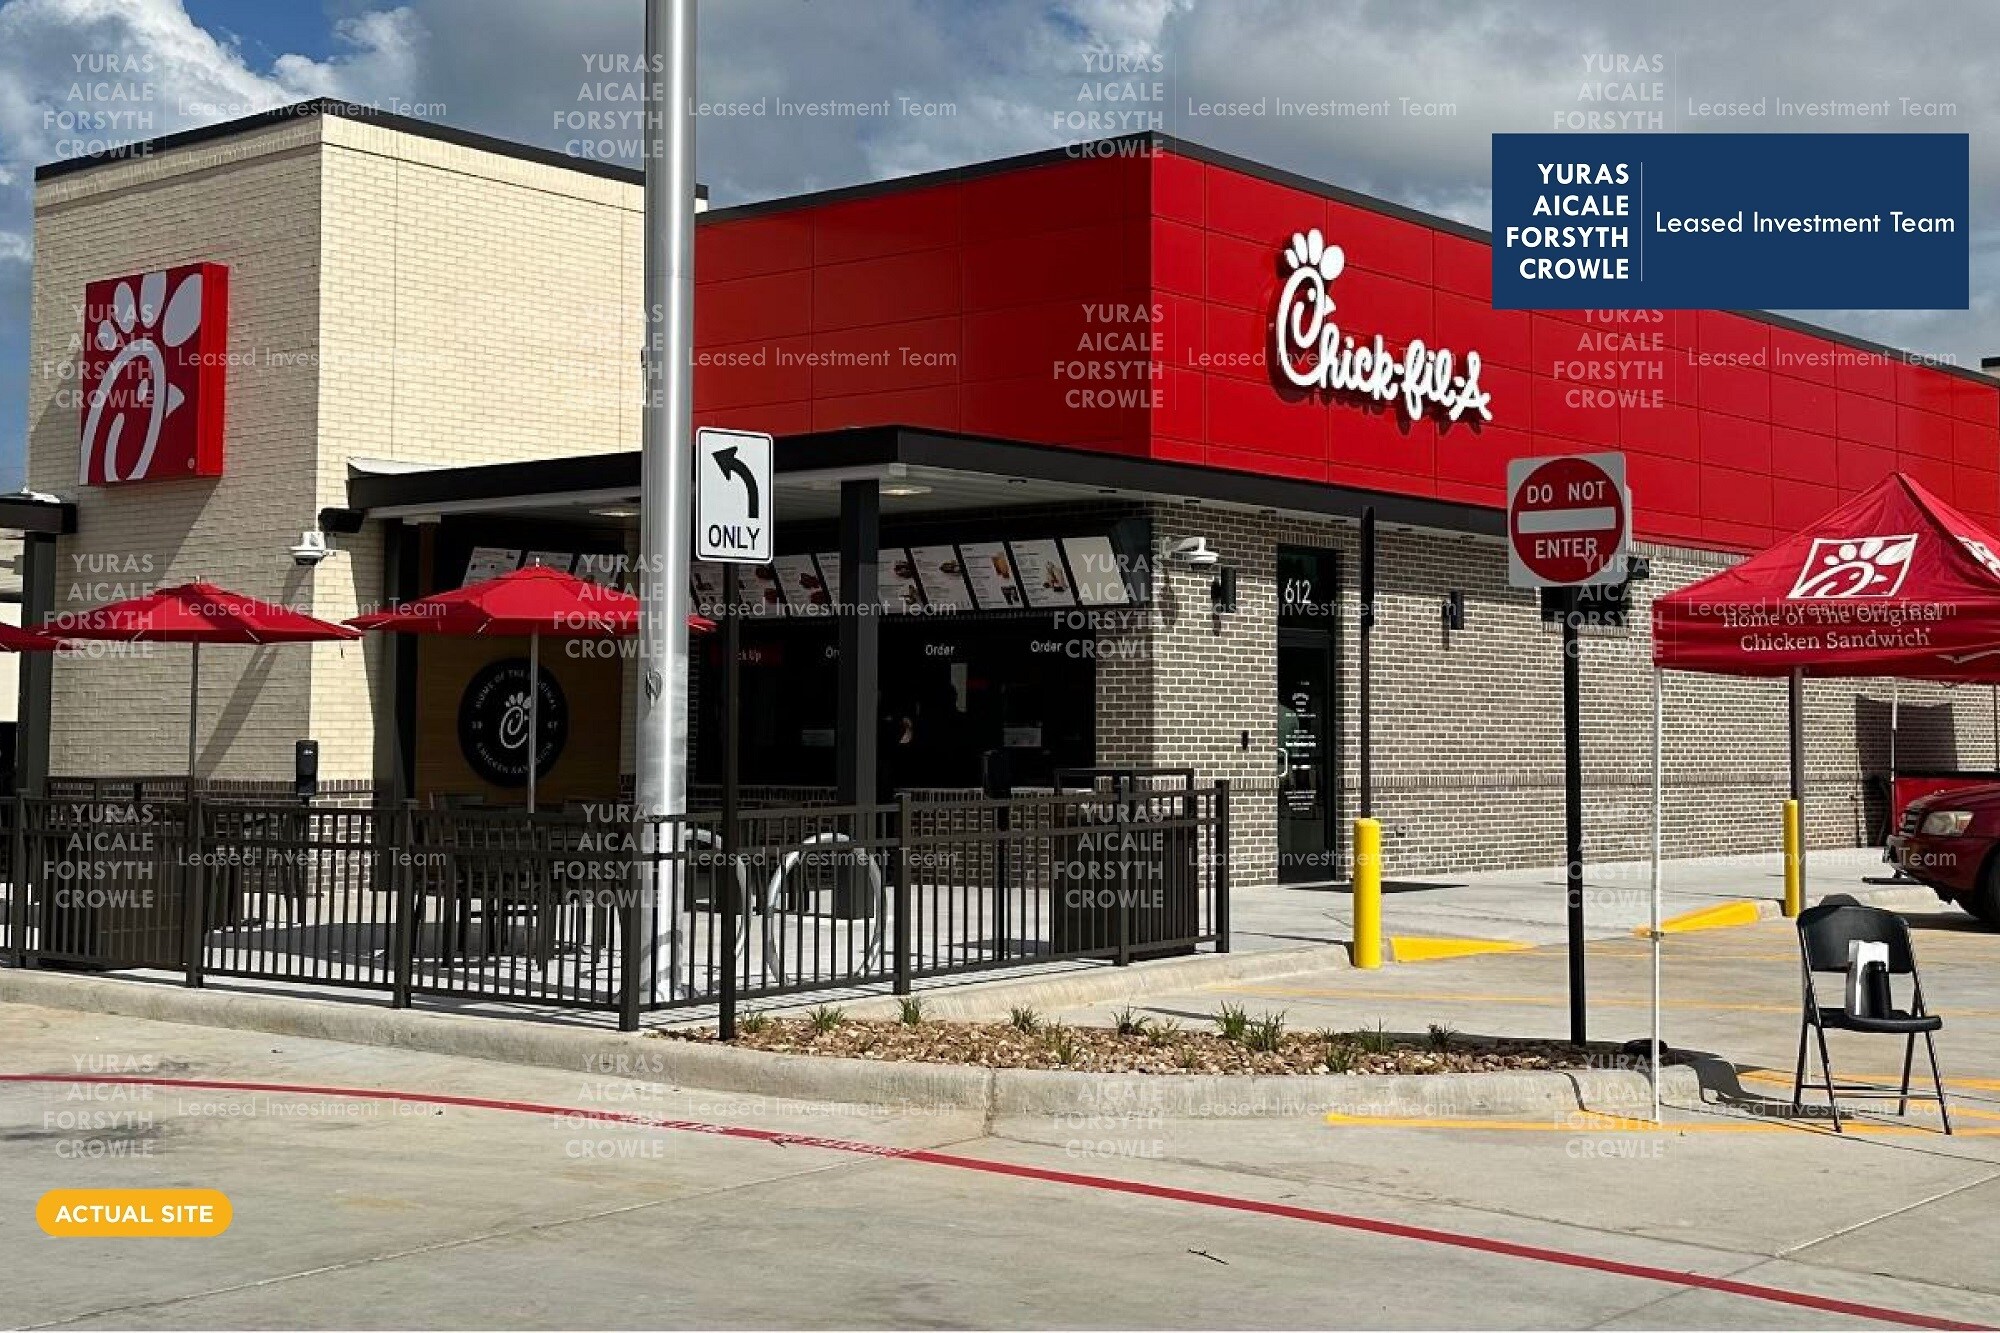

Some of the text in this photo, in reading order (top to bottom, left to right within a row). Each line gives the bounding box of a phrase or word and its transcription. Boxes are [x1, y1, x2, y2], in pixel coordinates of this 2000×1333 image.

[1276, 228, 1493, 421] Chick-fil-A
[1526, 481, 1606, 504] DO NOT
[709, 524, 761, 550] ONLY
[1535, 537, 1597, 559] ENTER
[1285, 578, 1311, 603] 612
[1723, 612, 1780, 627] Home
[1857, 603, 1943, 627] Original
[925, 644, 955, 656] Order
[1030, 640, 1062, 653] Order
[1740, 631, 1821, 651] Chicken
